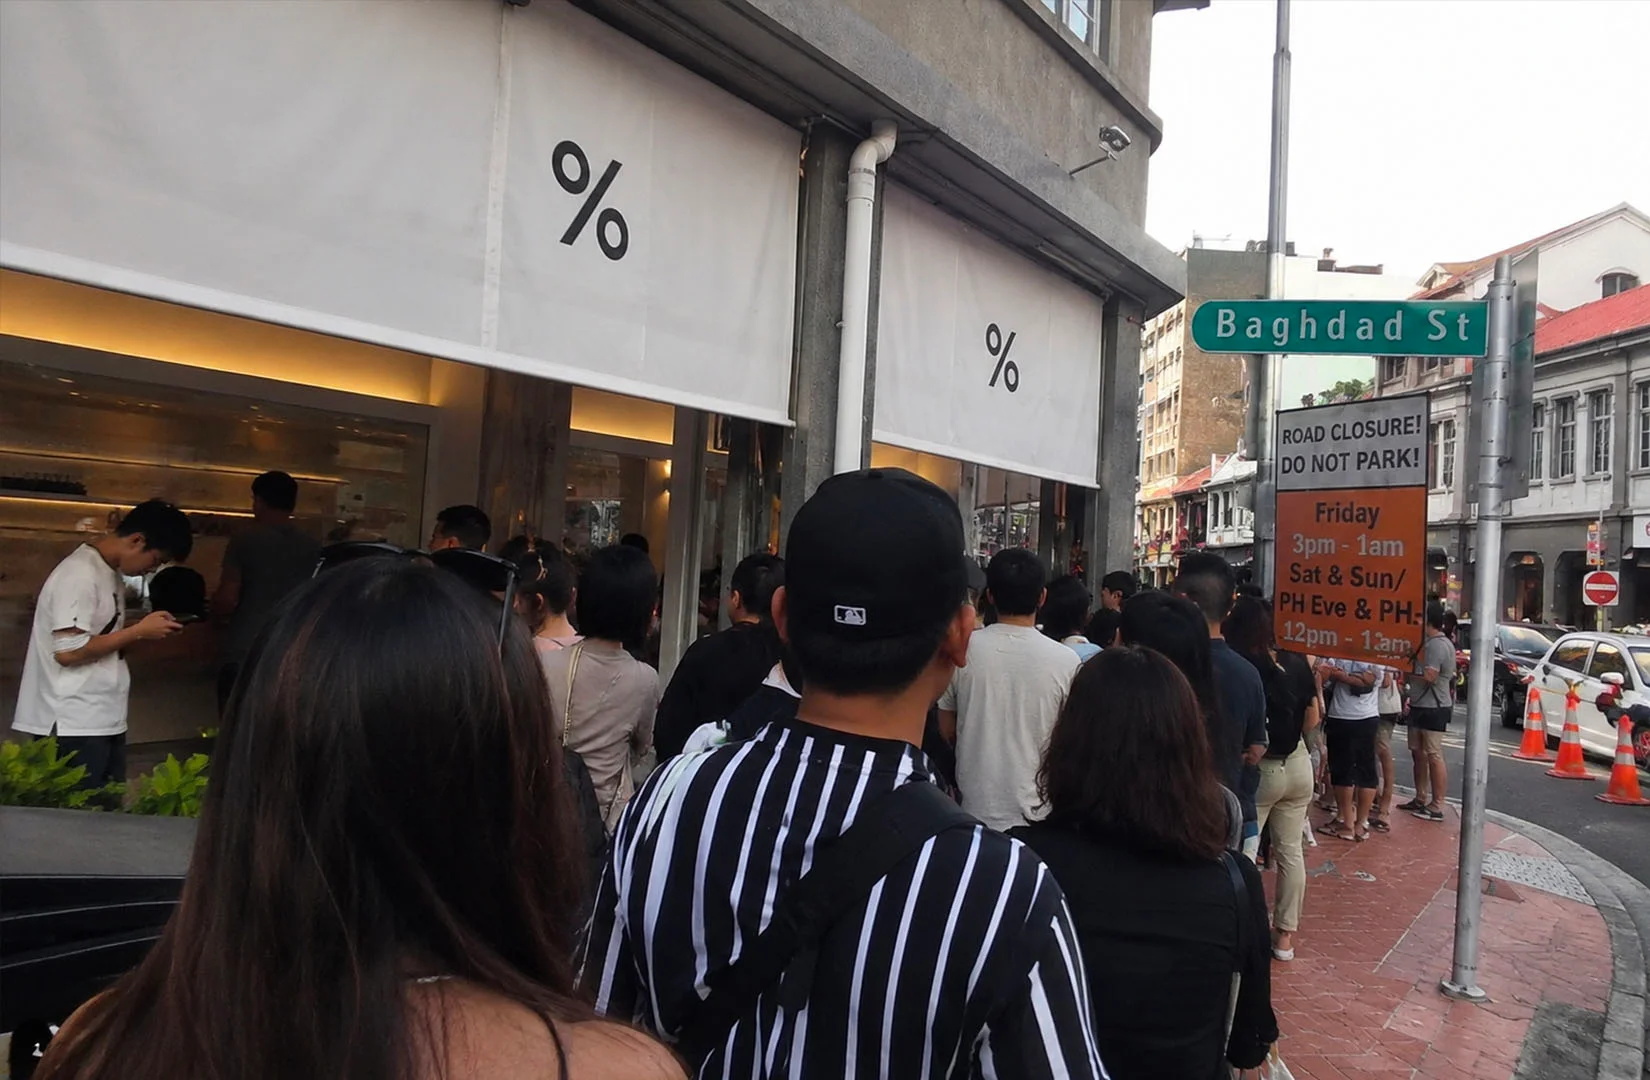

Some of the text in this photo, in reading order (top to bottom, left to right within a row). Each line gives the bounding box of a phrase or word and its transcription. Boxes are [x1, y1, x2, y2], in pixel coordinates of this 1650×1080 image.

[1216, 308, 1470, 346] Baghdad St
[1282, 414, 1422, 445] ROAD CLOSURE!
[1281, 447, 1420, 474] DO NOT PARK!
[1315, 501, 1380, 530] Friday
[1292, 533, 1336, 560] 3pm
[1356, 533, 1404, 557] 1am
[1290, 562, 1406, 593] Sat & Sun/
[1279, 592, 1305, 614] PH
[1311, 595, 1347, 618] Eve
[1354, 597, 1372, 620] &
[1283, 620, 1338, 648] 12pm
